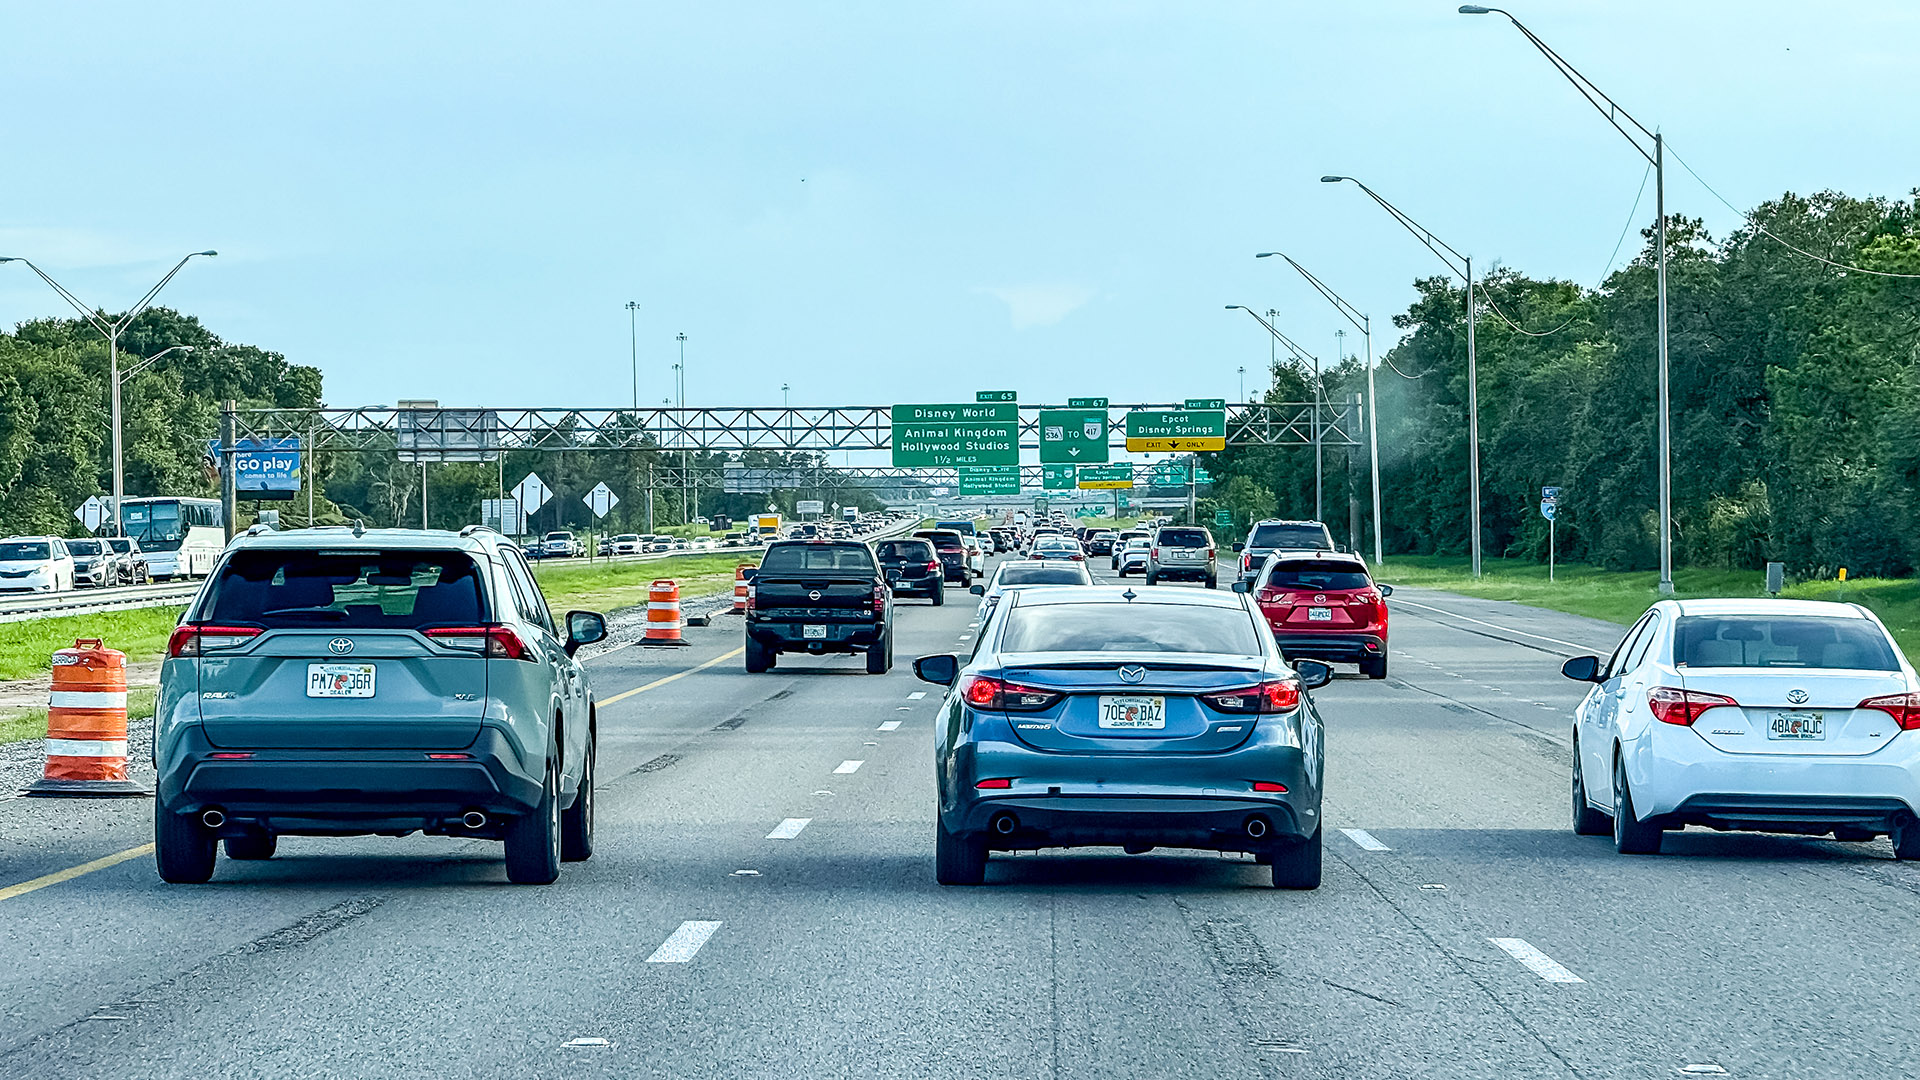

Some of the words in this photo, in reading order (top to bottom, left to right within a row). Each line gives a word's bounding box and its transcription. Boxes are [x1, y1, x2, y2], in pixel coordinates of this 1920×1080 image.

[1000, 392, 1013, 400] 65
[1092, 399, 1105, 407] 67
[914, 409, 956, 420] Disney
[962, 408, 996, 418] World
[1161, 415, 1189, 424] Epcot
[904, 428, 949, 438] Animal
[954, 428, 1007, 439] Kingdom
[1067, 430, 1080, 439] TO
[1085, 427, 1097, 436] 417
[1138, 426, 1172, 435] Disney
[1175, 425, 1214, 435] Springs
[901, 441, 960, 453] Hollywood
[965, 441, 1010, 451] Studios
[956, 455, 977, 463] MILES
[263, 457, 293, 472] play
[311, 673, 334, 689] PM7
[348, 673, 371, 689] 36R
[1139, 705, 1162, 721] BAZ
